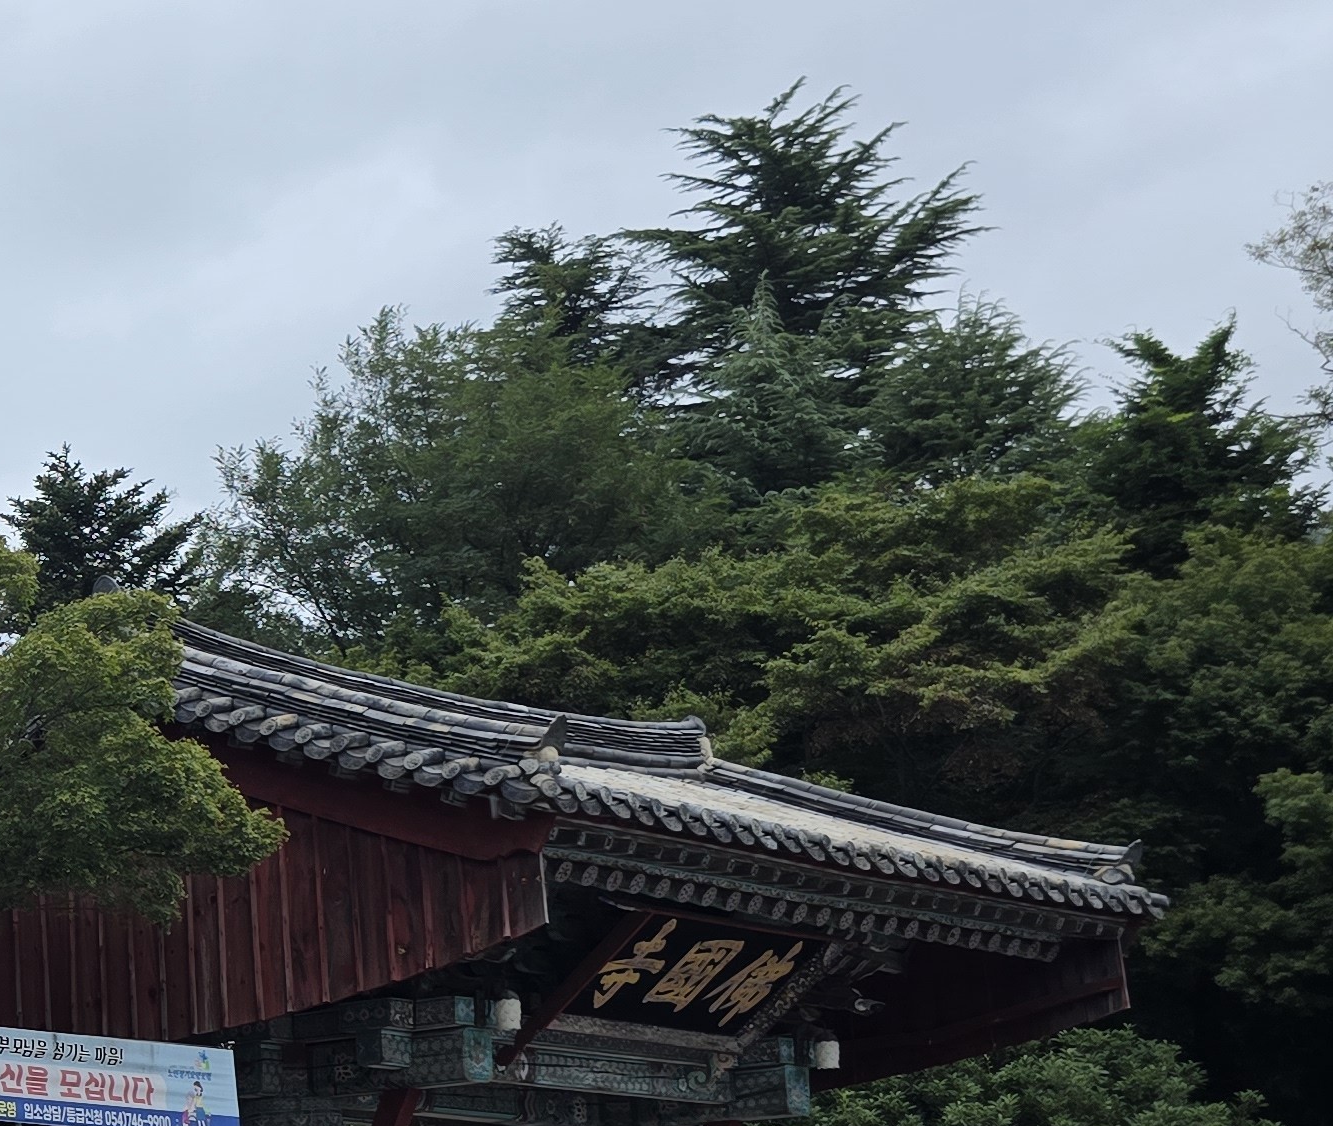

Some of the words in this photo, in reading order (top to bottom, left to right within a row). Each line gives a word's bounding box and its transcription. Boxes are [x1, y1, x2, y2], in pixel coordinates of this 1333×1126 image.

[52, 1041, 91, 1063] 섬기는
[95, 1046, 124, 1066] 마음!
[59, 1069, 155, 1106] 모십니다
[23, 1103, 104, 1126] 입소상담/등급신청
